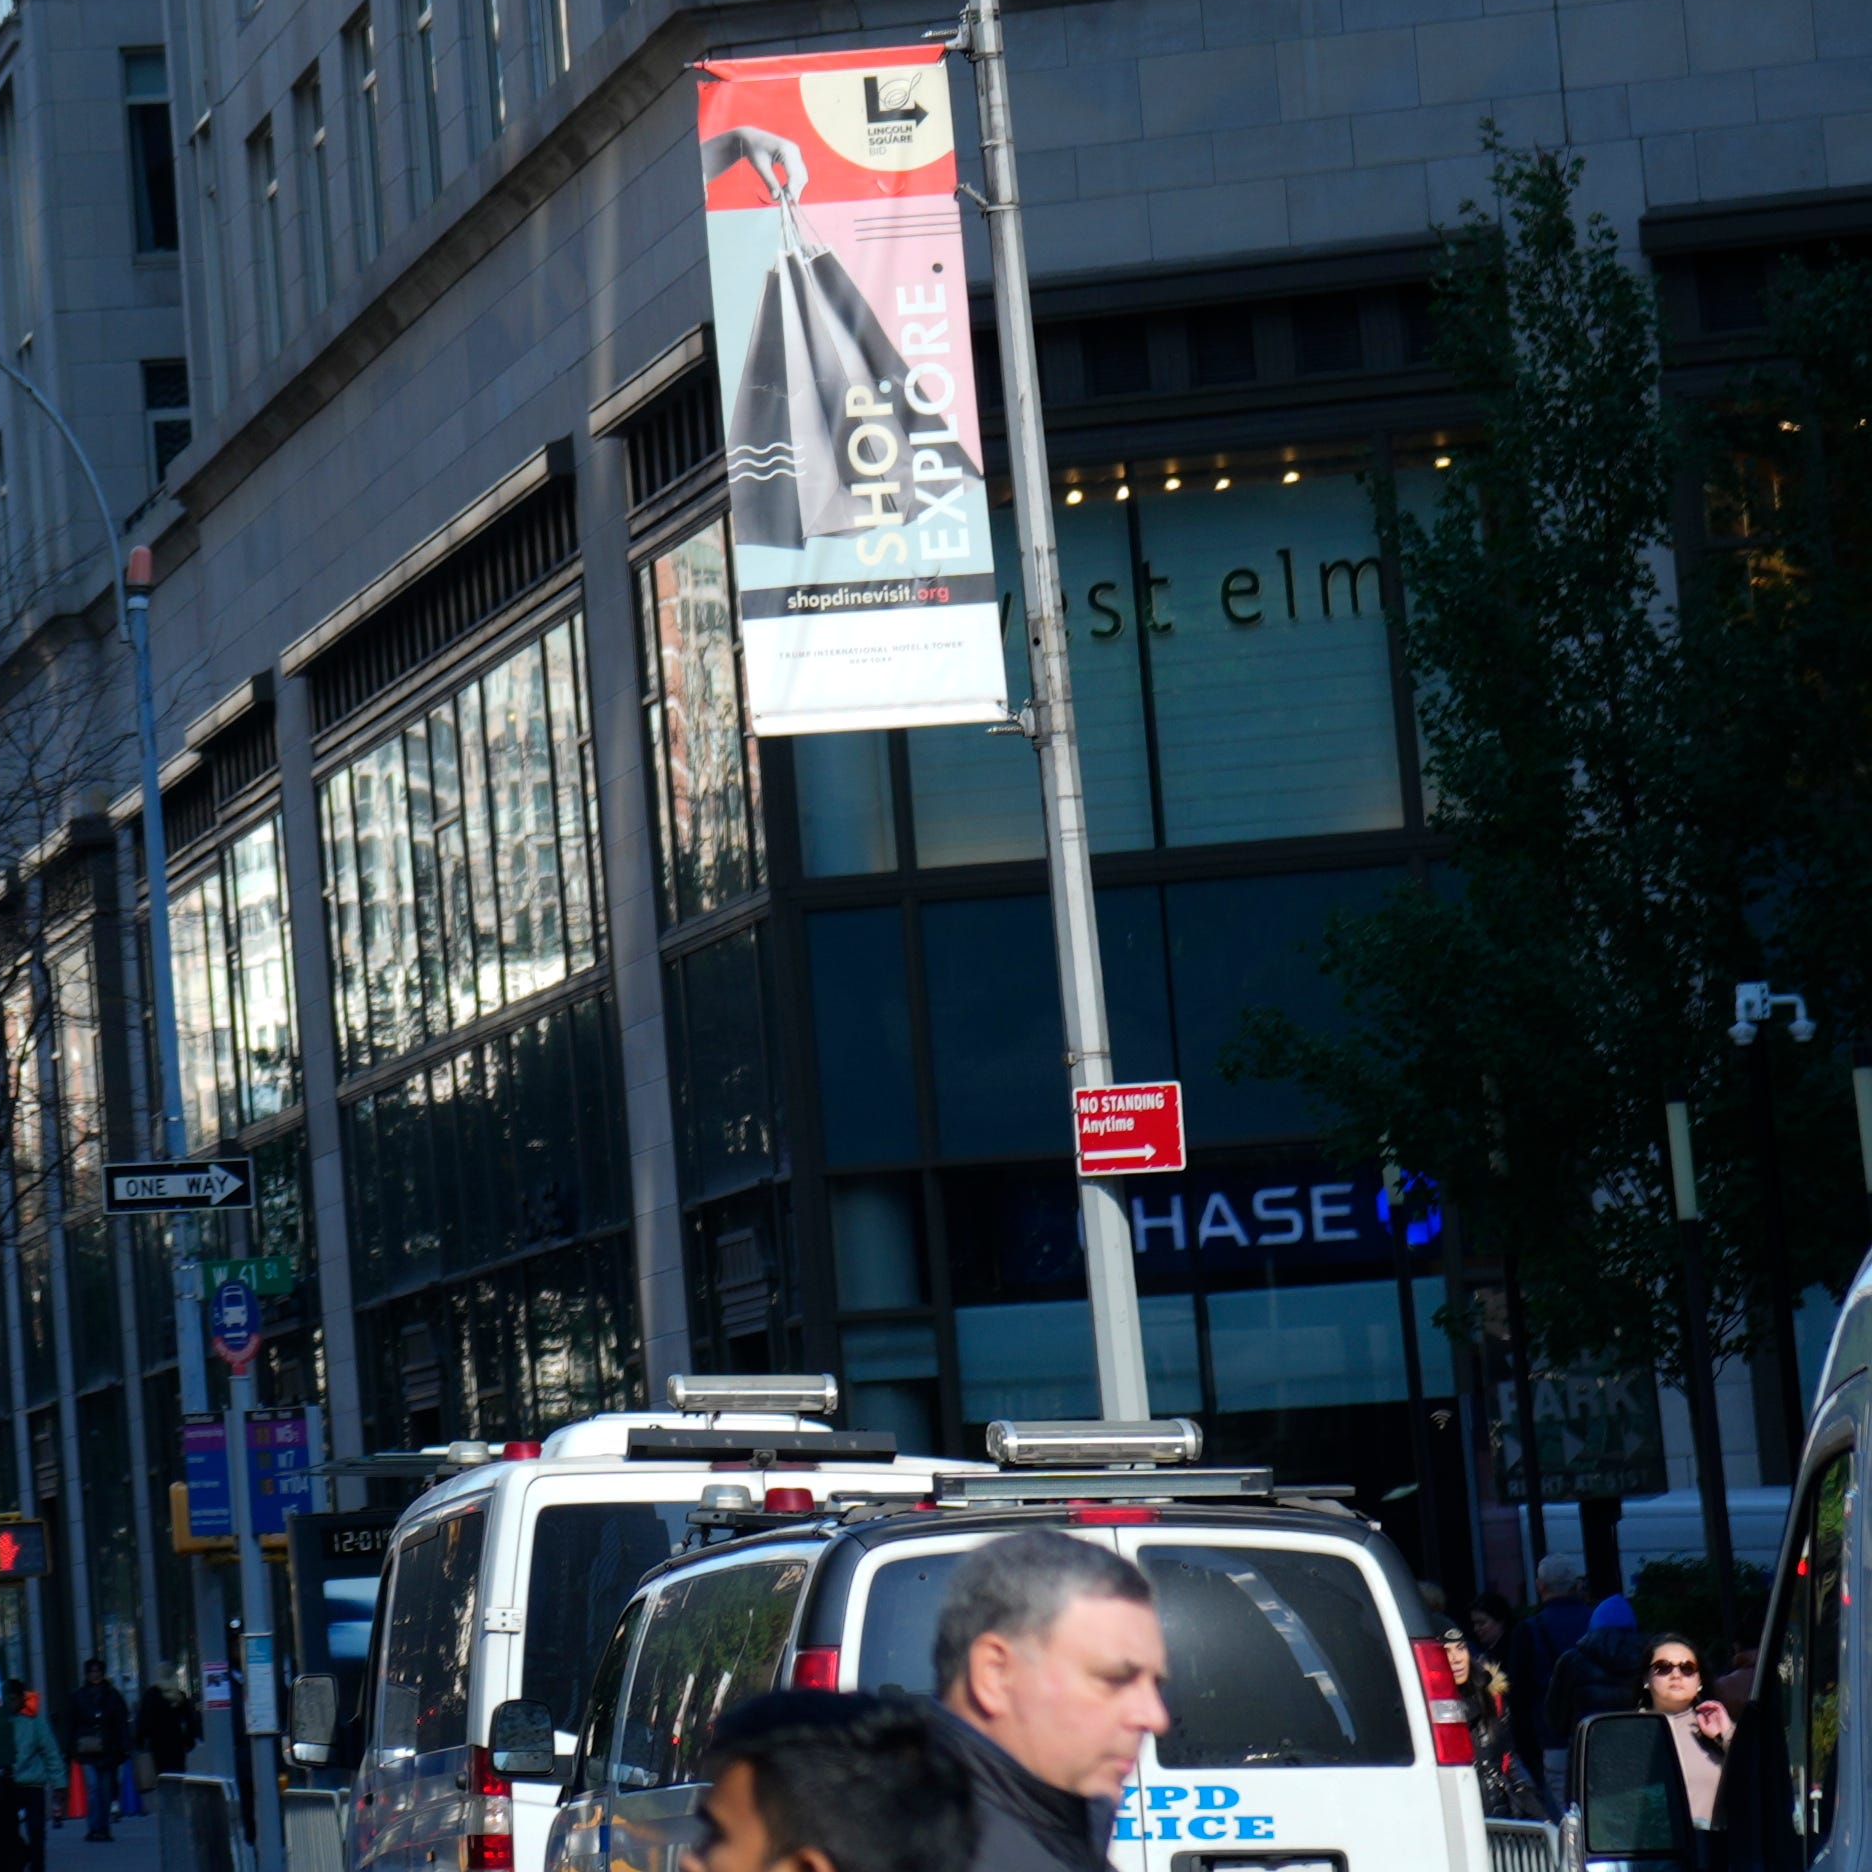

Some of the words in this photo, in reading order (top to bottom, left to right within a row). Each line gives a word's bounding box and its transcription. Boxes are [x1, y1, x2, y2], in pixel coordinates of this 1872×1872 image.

[867, 125, 913, 137] LINCOLN
[868, 134, 913, 146] SQUARE
[869, 146, 887, 156] BID
[1220, 547, 1386, 626] elm
[787, 584, 950, 611] shopdinevisit.org
[813, 645, 888, 657] INTERNATIONAL
[892, 642, 920, 652] HOTEL
[1079, 1096, 1098, 1114] NO
[1101, 1092, 1165, 1112] STANDING
[1082, 1115, 1135, 1136] Anytime
[126, 1178, 167, 1197] ONE
[186, 1176, 229, 1194] WAY
[1077, 1182, 1360, 1253] HASE
[1120, 1785, 1240, 1810] YPD
[1113, 1815, 1275, 1840] LICE
